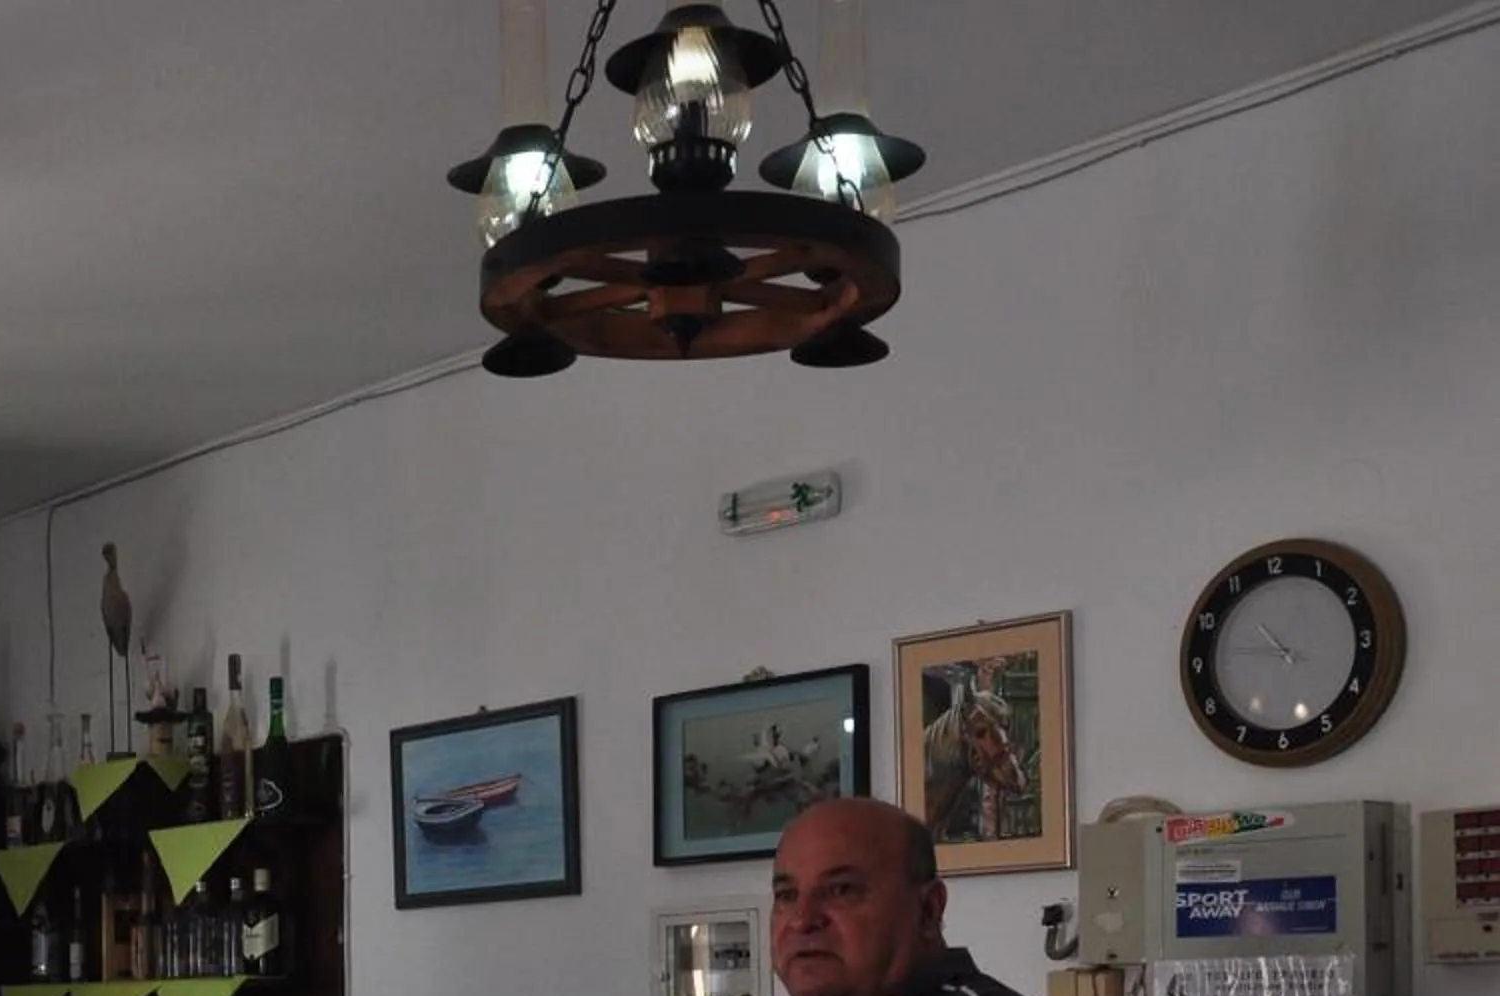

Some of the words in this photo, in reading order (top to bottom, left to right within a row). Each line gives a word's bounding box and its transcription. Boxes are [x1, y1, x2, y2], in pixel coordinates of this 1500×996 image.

[1267, 556, 1283, 575] 12
[1315, 559, 1322, 577] 1
[1229, 575, 1241, 593] 11
[1347, 586, 1359, 605] 2
[1199, 612, 1215, 632] 10
[1359, 629, 1372, 649] 3
[1192, 656, 1204, 674] 9
[1348, 677, 1360, 694] 4
[1204, 696, 1216, 715] 8
[1320, 714, 1333, 733] 5
[1235, 725, 1248, 743] 7
[1277, 731, 1290, 749] 6
[1175, 888, 1249, 908] SPORT
[1189, 905, 1243, 921] AWAY
